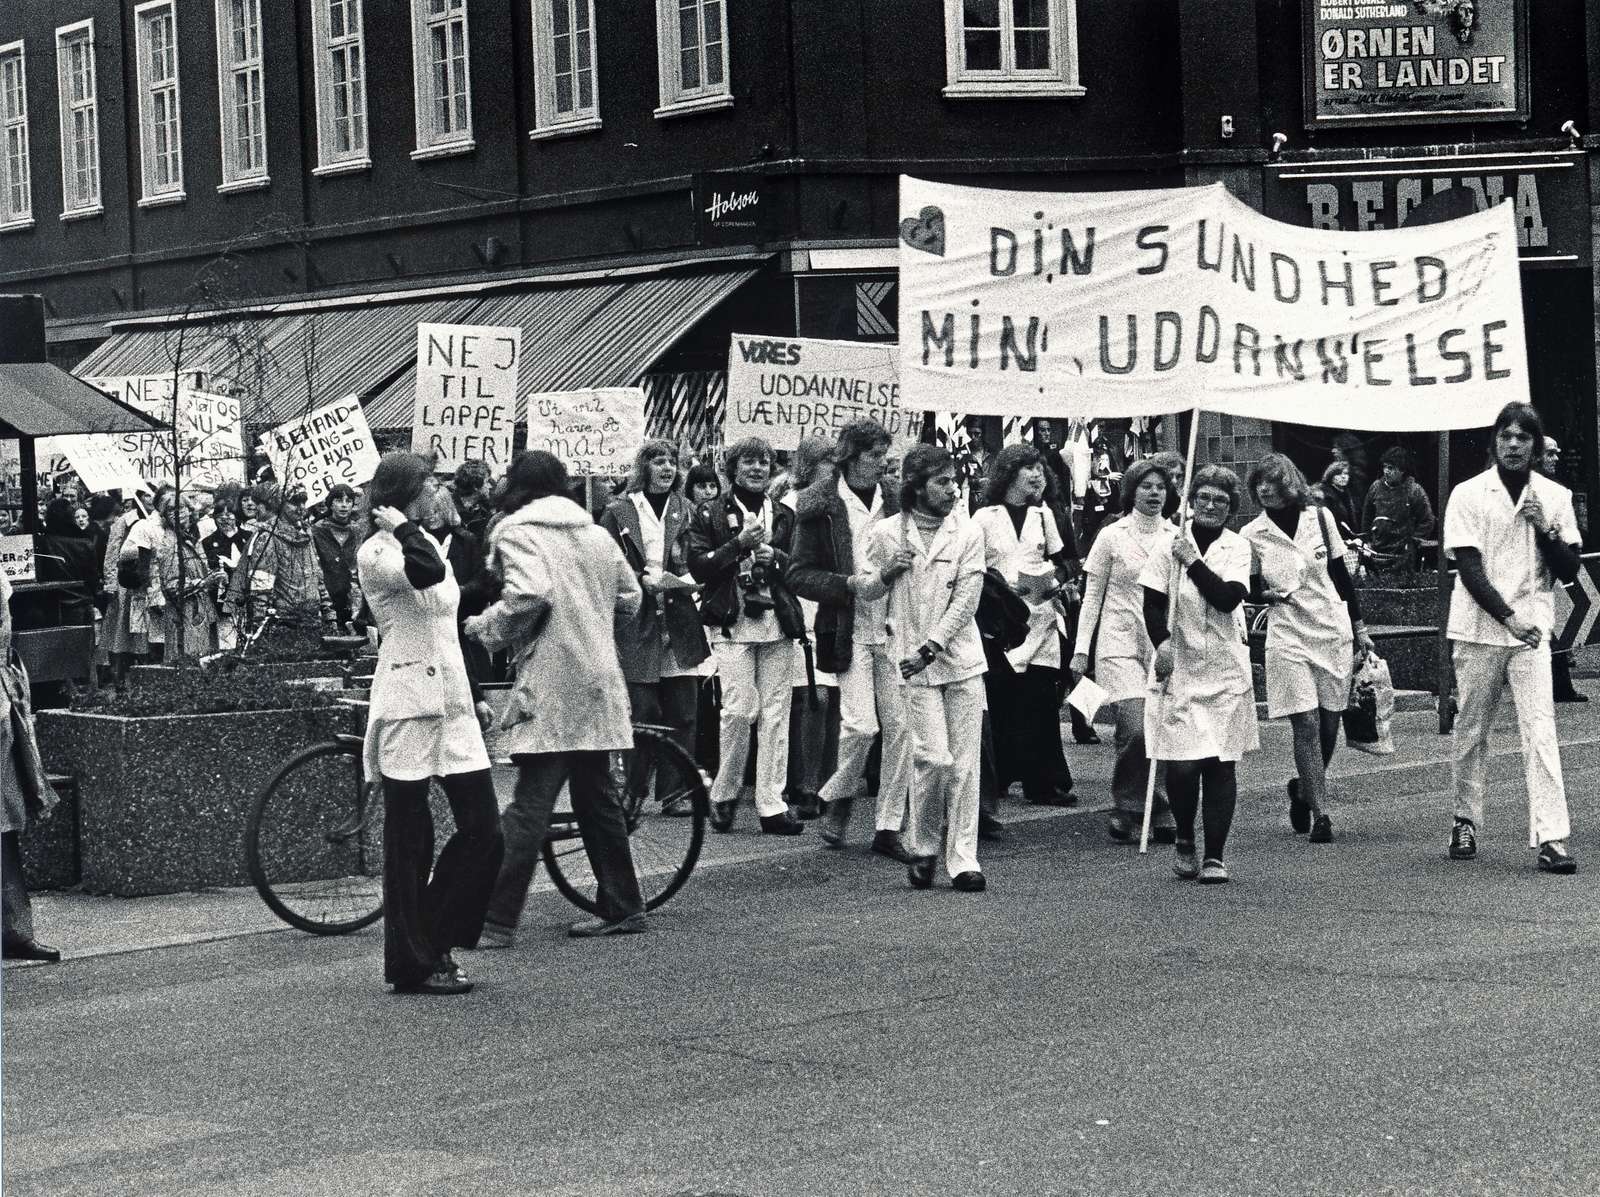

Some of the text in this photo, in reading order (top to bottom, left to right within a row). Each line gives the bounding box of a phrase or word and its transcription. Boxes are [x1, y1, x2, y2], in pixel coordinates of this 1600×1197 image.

[1320, 5, 1408, 20] DONALD SUTHERLAND
[1320, 26, 1435, 61] ØRNEN
[1323, 55, 1506, 90] ER LANDET
[705, 190, 759, 221] Hobson
[428, 334, 516, 370] NEJ
[441, 375, 494, 398] TIL
[760, 373, 900, 408] UDDANNELSE
[276, 404, 359, 452] BEHAND-
[423, 405, 517, 431] LAPPE-
[430, 435, 510, 464] RIER!
[294, 460, 318, 480] OG
